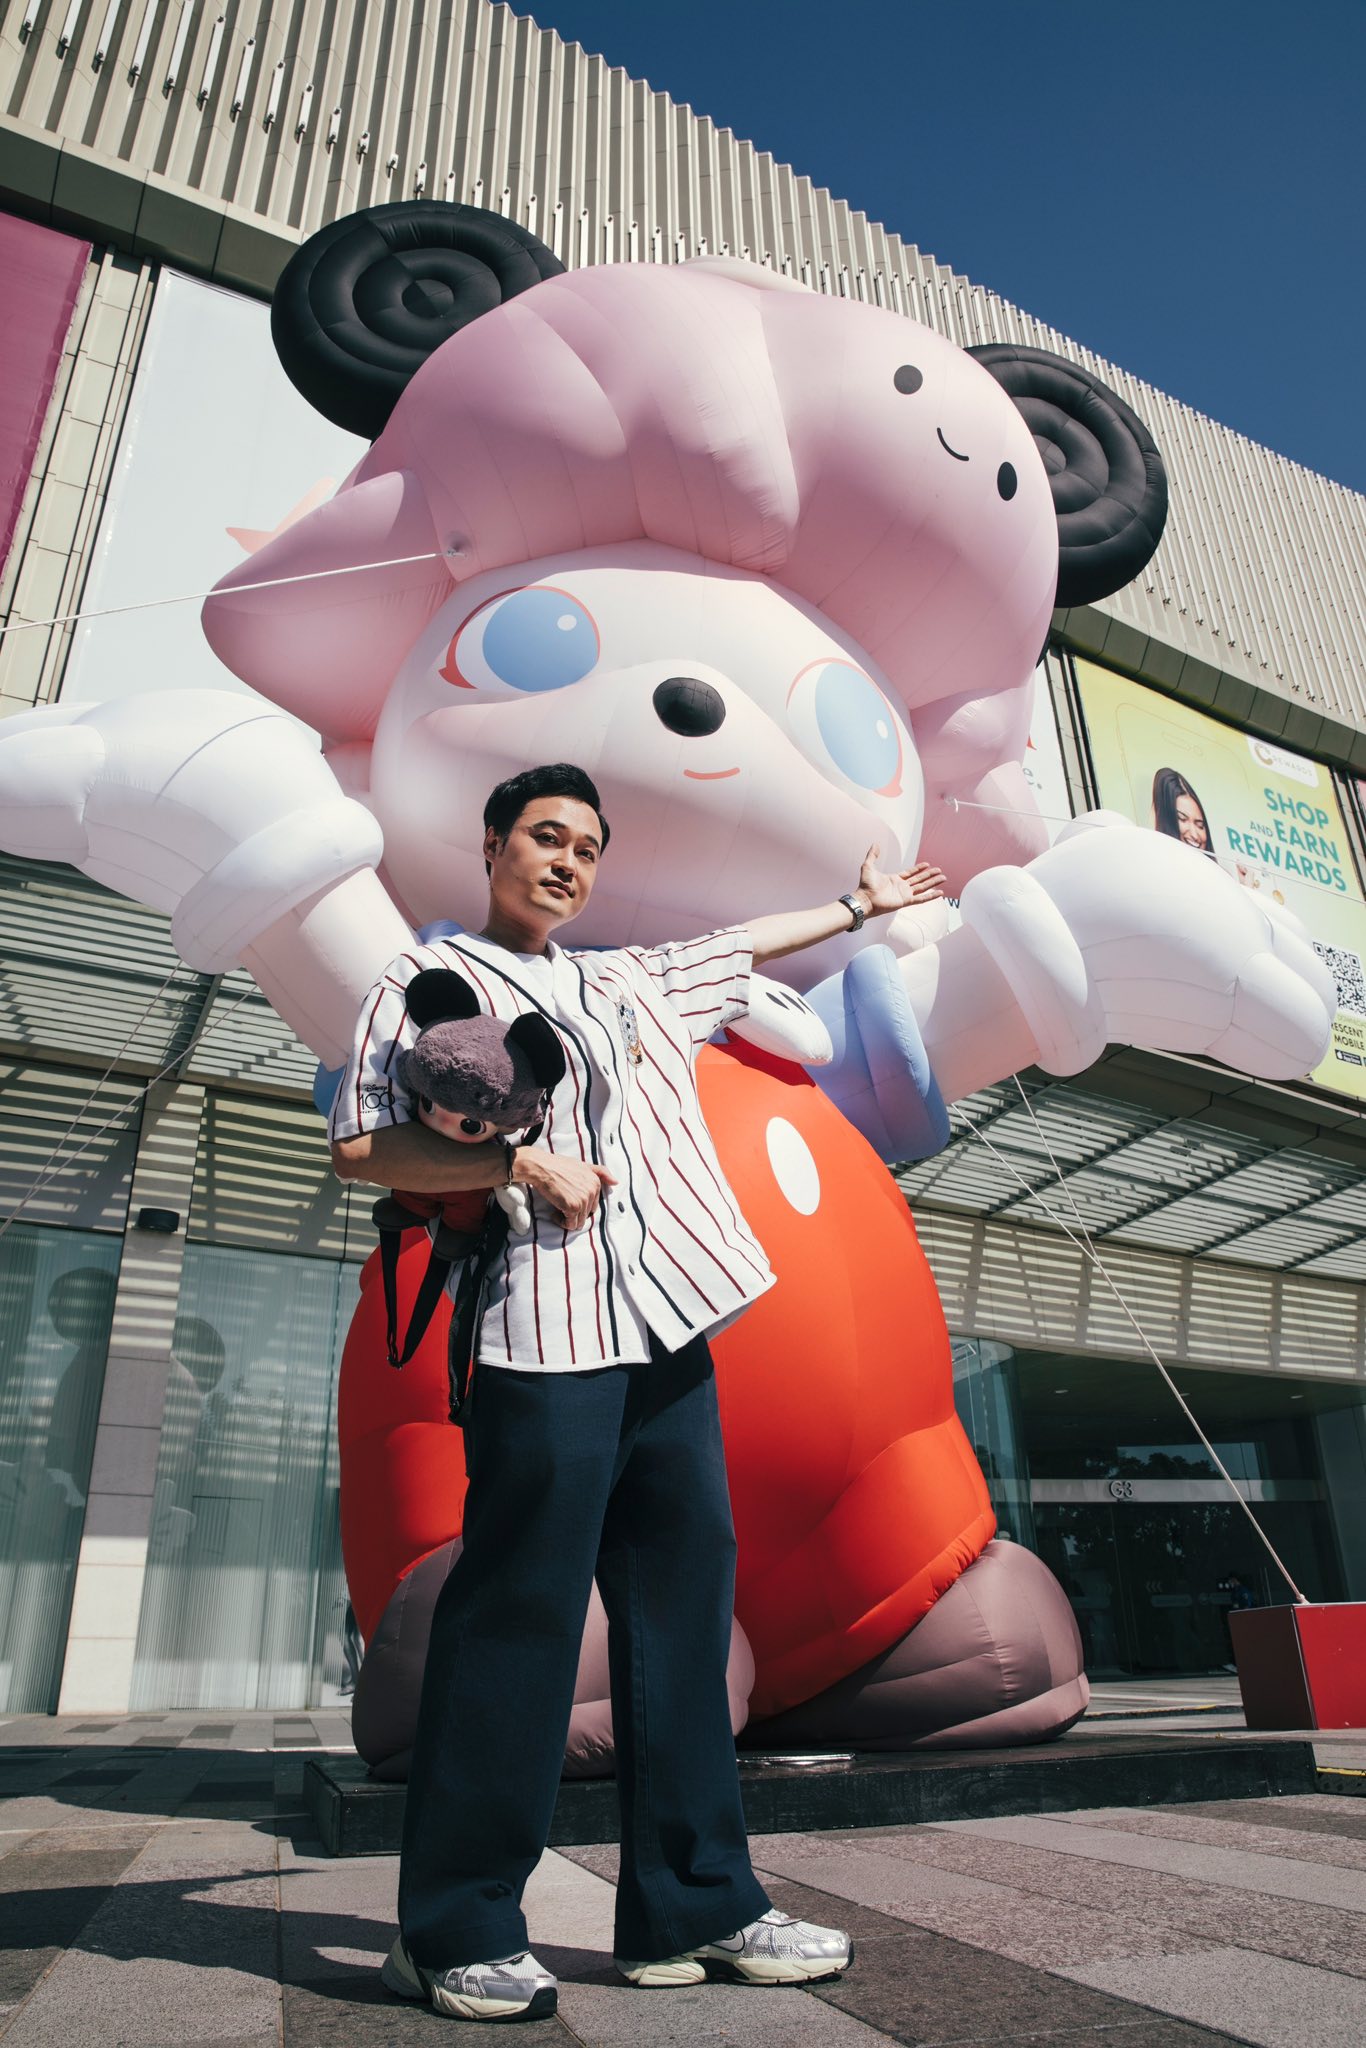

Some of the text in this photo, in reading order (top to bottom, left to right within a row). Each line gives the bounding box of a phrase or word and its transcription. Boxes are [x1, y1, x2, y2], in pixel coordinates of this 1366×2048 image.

[1264, 788, 1329, 830] SHOP
[1250, 819, 1340, 864] AND EARN
[1226, 827, 1347, 891] REWARDS
[1334, 1034, 1366, 1051] MOBILE
[359, 1091, 395, 1110] 100
[1109, 1480, 1134, 1499] G3
